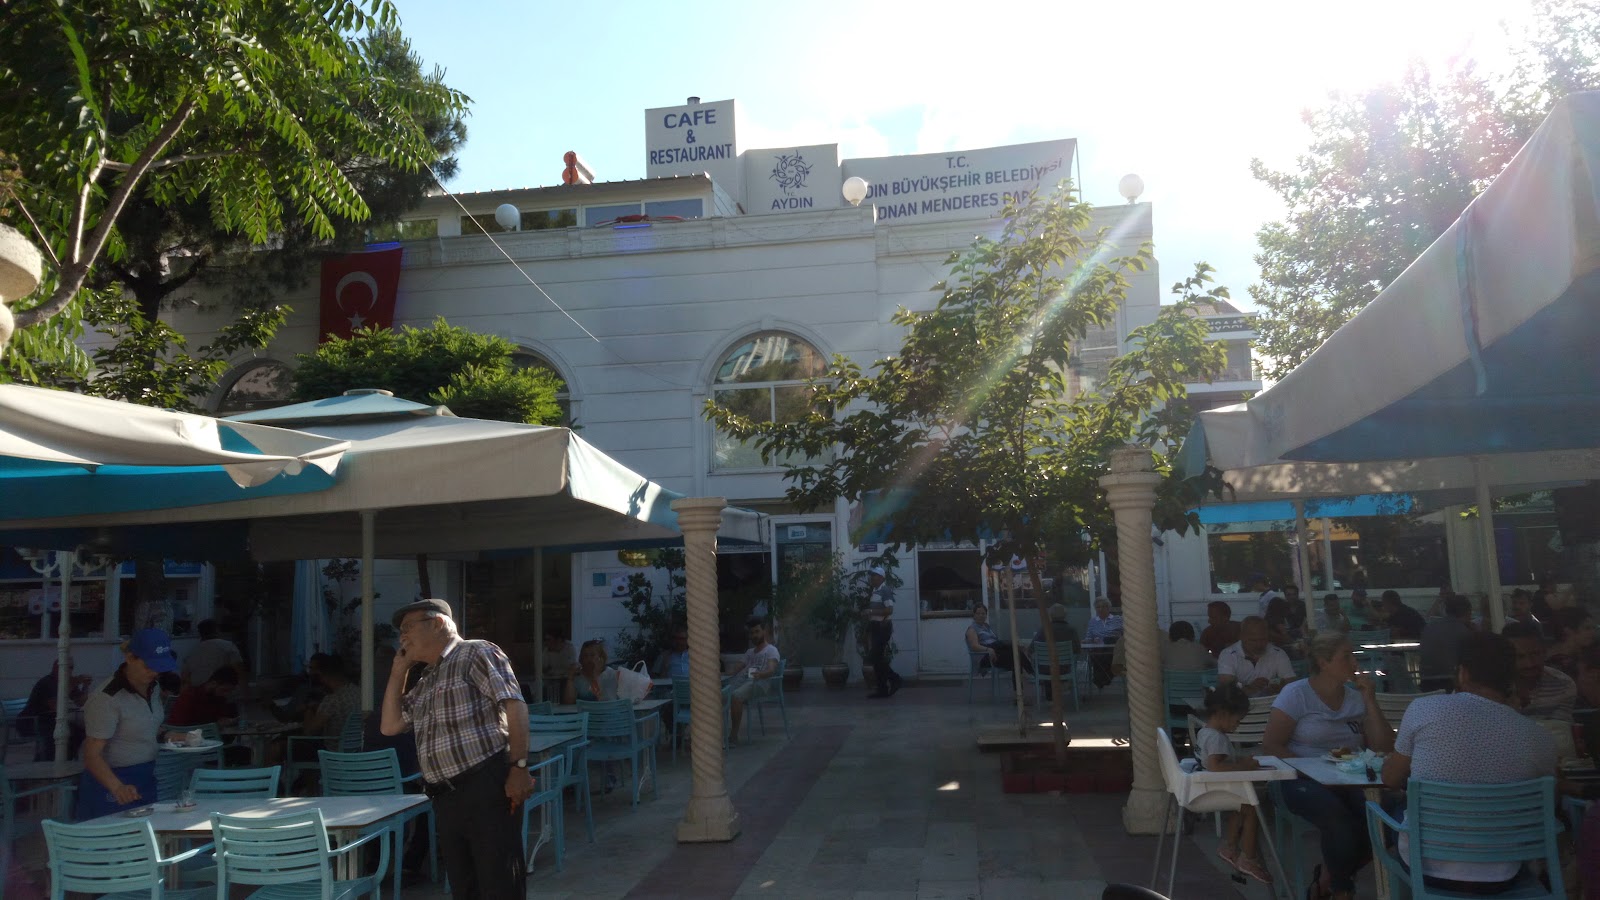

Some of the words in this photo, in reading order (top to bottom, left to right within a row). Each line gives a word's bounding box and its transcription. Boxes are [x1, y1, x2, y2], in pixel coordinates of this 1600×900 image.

[664, 109, 716, 129] CAFE
[686, 129, 696, 144] &
[650, 144, 732, 165] RESTAURANT
[946, 156, 969, 169] T.C.
[865, 183, 888, 199] DIN
[892, 171, 981, 195] BÜYÜKŞEHİR
[771, 197, 813, 210] AYDIN
[878, 202, 917, 220] DNAN
[921, 193, 999, 215] MENDERES
